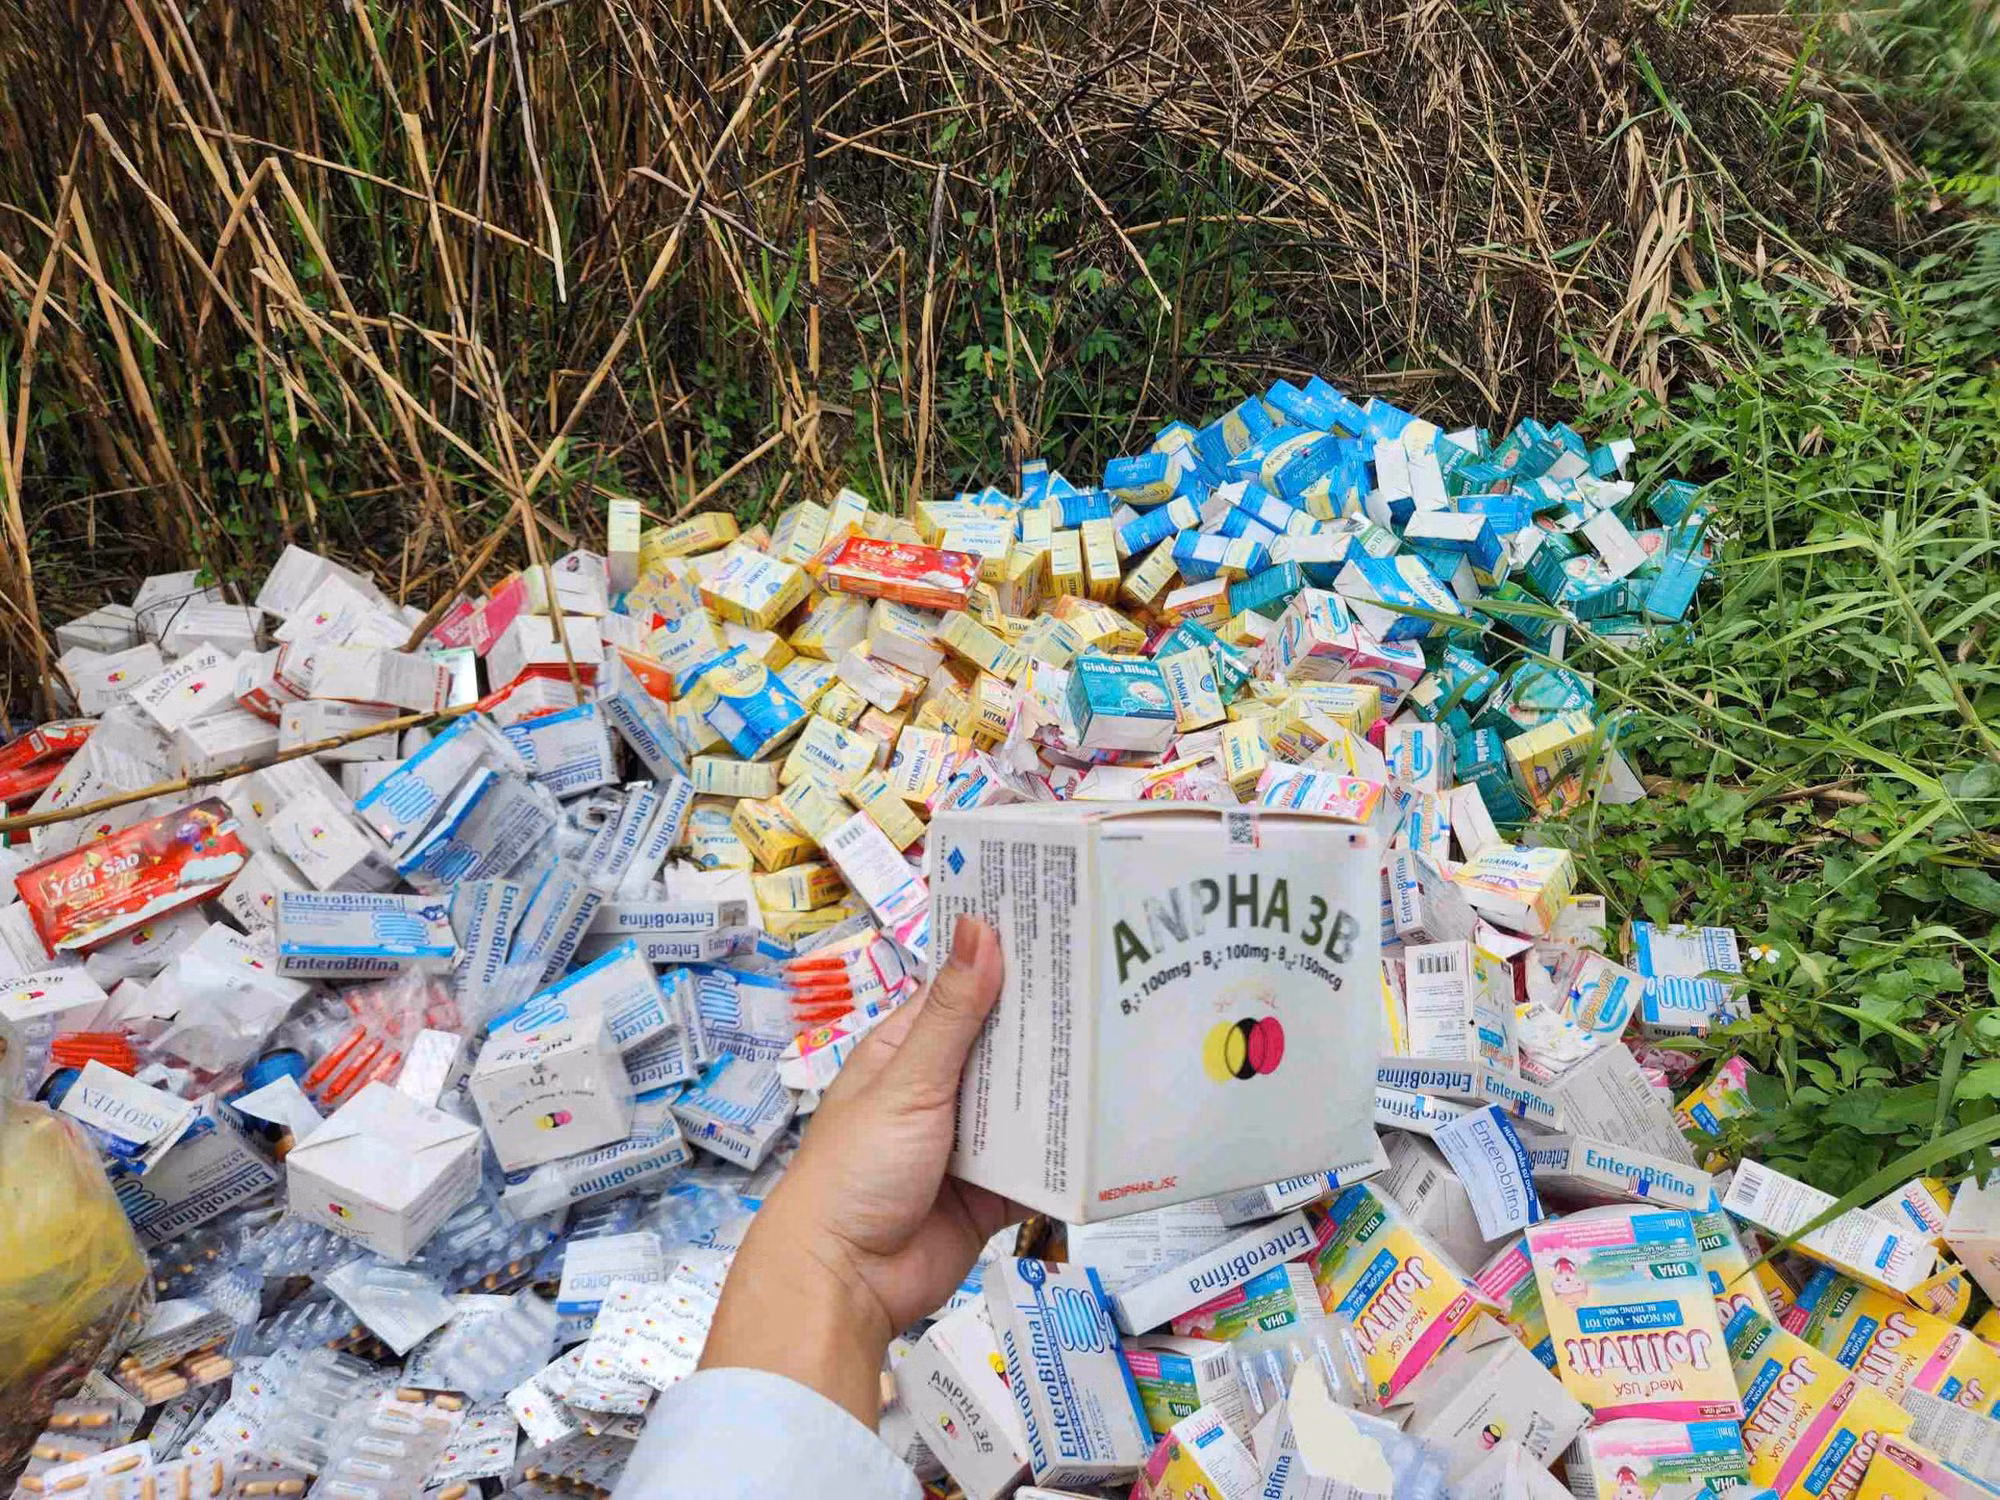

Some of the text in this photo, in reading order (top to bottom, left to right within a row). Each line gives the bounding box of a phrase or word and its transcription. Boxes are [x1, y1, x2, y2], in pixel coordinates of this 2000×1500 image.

[1008, 622, 1030, 630] VITAM
[1082, 661, 1160, 677] Ginkgo Biloba
[1170, 662, 1188, 699] VITAMIN
[607, 699, 662, 762] EnteroBifina
[983, 708, 1007, 726] VITAM
[805, 742, 838, 768] VITAMIN
[548, 766, 603, 795] EnteroBi
[907, 756, 926, 791] VITAMIN
[646, 782, 694, 860] EnteroBifina
[102, 851, 140, 880] Sào
[283, 891, 394, 905] EnteroBifina
[483, 885, 519, 983] EnteroBifina
[619, 911, 714, 928] EnteroBifina
[1112, 873, 1360, 985] ANPHA 3B
[541, 893, 602, 984] EnteroBifina
[648, 943, 700, 959] EnteroB
[1714, 927, 1738, 972] EnteroB
[285, 957, 399, 972] EnteroBifina
[1141, 961, 1191, 996] 100mg
[1226, 944, 1269, 962] 100mg
[1299, 953, 1343, 991] 150mcg
[631, 1060, 684, 1086] Entero
[1377, 1068, 1473, 1092] EnteroBifina
[1485, 1075, 1556, 1119] EnteroBifina
[570, 1149, 685, 1198] EnteroBifina
[1471, 1118, 1522, 1221] Enterobifina
[1529, 1149, 1570, 1170] EnteroB
[1585, 1149, 1696, 1198] EnteroBifina
[158, 1168, 274, 1232] EnteroBifina
[1361, 1214, 1381, 1238] DHA
[1189, 1225, 1311, 1294] EnteroBifina
[1658, 1262, 1688, 1278] DHA
[1354, 1255, 1433, 1357] Jollivi
[1631, 1311, 1661, 1325] NGON
[1834, 1290, 1852, 1315] DHA
[1263, 1313, 1288, 1329] DHA
[1564, 1329, 1712, 1378] Jollivit
[1747, 1330, 1766, 1357] DHA
[1856, 1311, 1919, 1386] Jolli
[1002, 1328, 1049, 1475] EnteroBifina
[1028, 1320, 1077, 1458] EnteroBifina
[1614, 1381, 1643, 1396] USA
[1750, 1377, 1770, 1403] NGON
[930, 1370, 995, 1454] ANPHA 3B
[1173, 1403, 1192, 1416] DHA
[1741, 1355, 1818, 1466] Jolliv
[1264, 1454, 1293, 1500] Bifina
[1713, 1475, 1739, 1490] DHA
